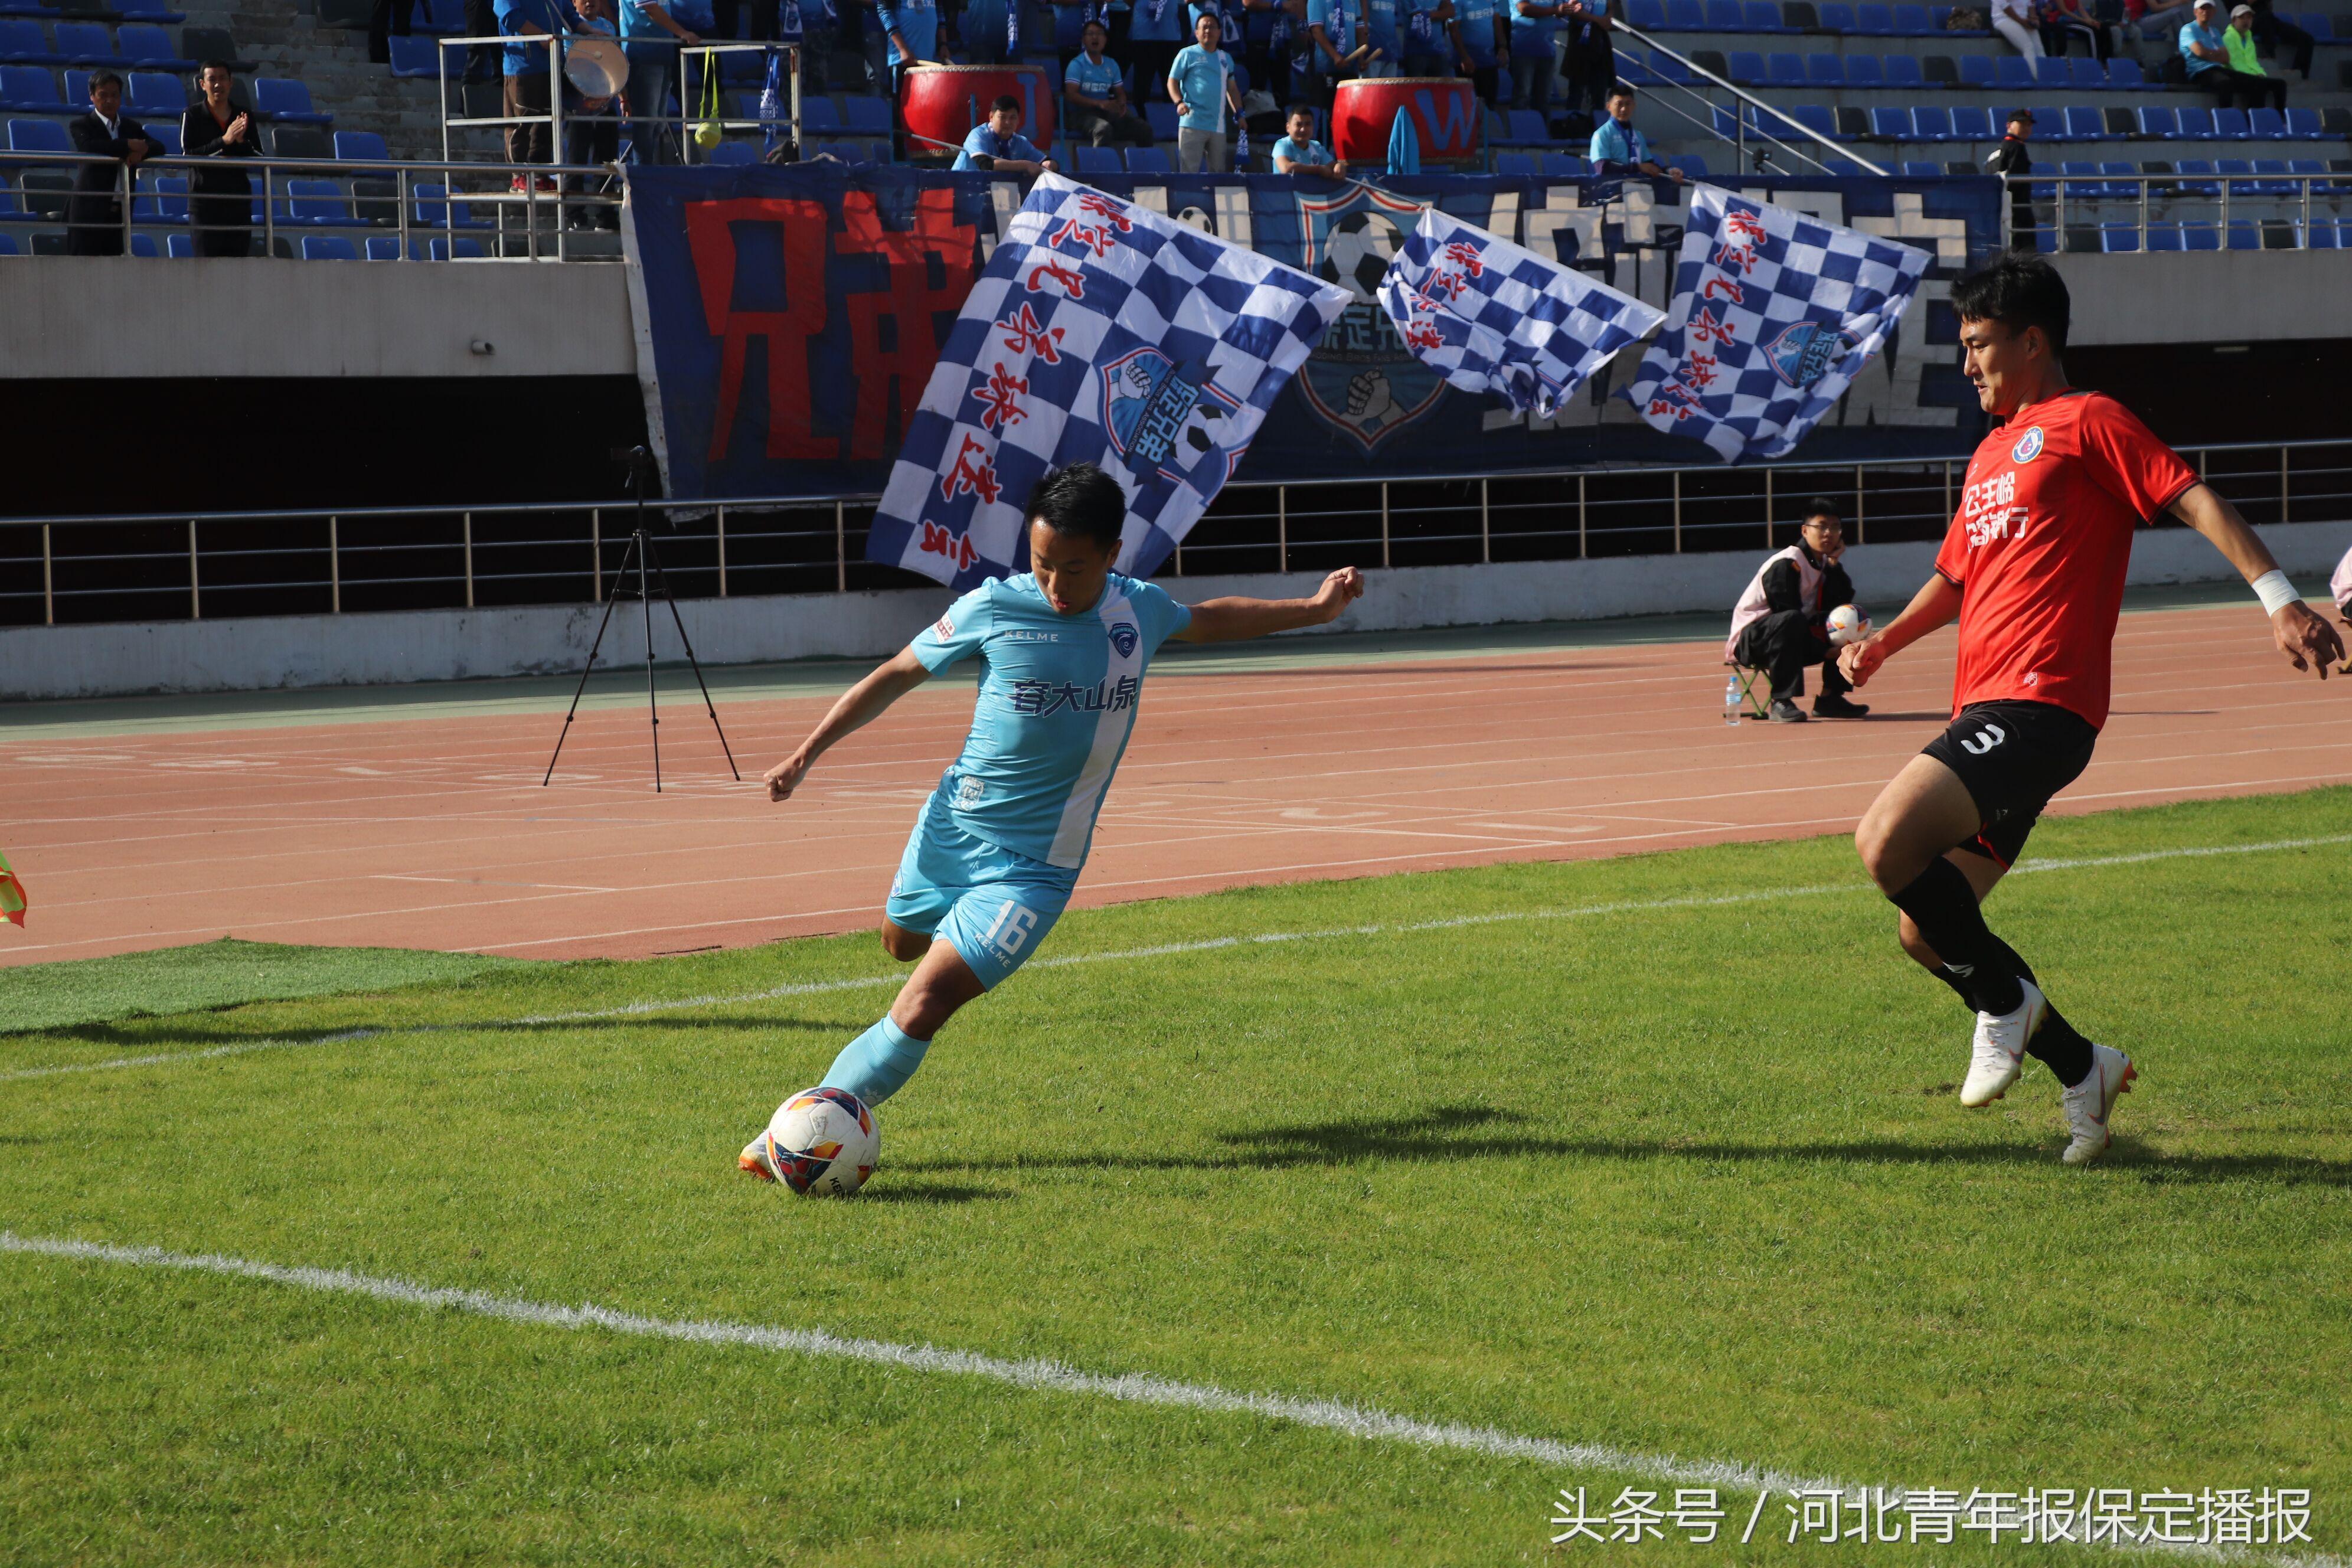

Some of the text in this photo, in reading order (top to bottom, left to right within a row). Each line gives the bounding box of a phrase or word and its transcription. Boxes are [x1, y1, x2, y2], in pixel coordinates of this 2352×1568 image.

[1135, 375, 1200, 463] 保定兄弟
[1965, 471, 2015, 518] 公主岭
[1004, 629, 1059, 642] KELME
[1007, 674, 1139, 718] 容大山泉
[1960, 723, 2005, 754] 3
[985, 899, 1038, 955] 16
[975, 932, 1011, 968] KELME
